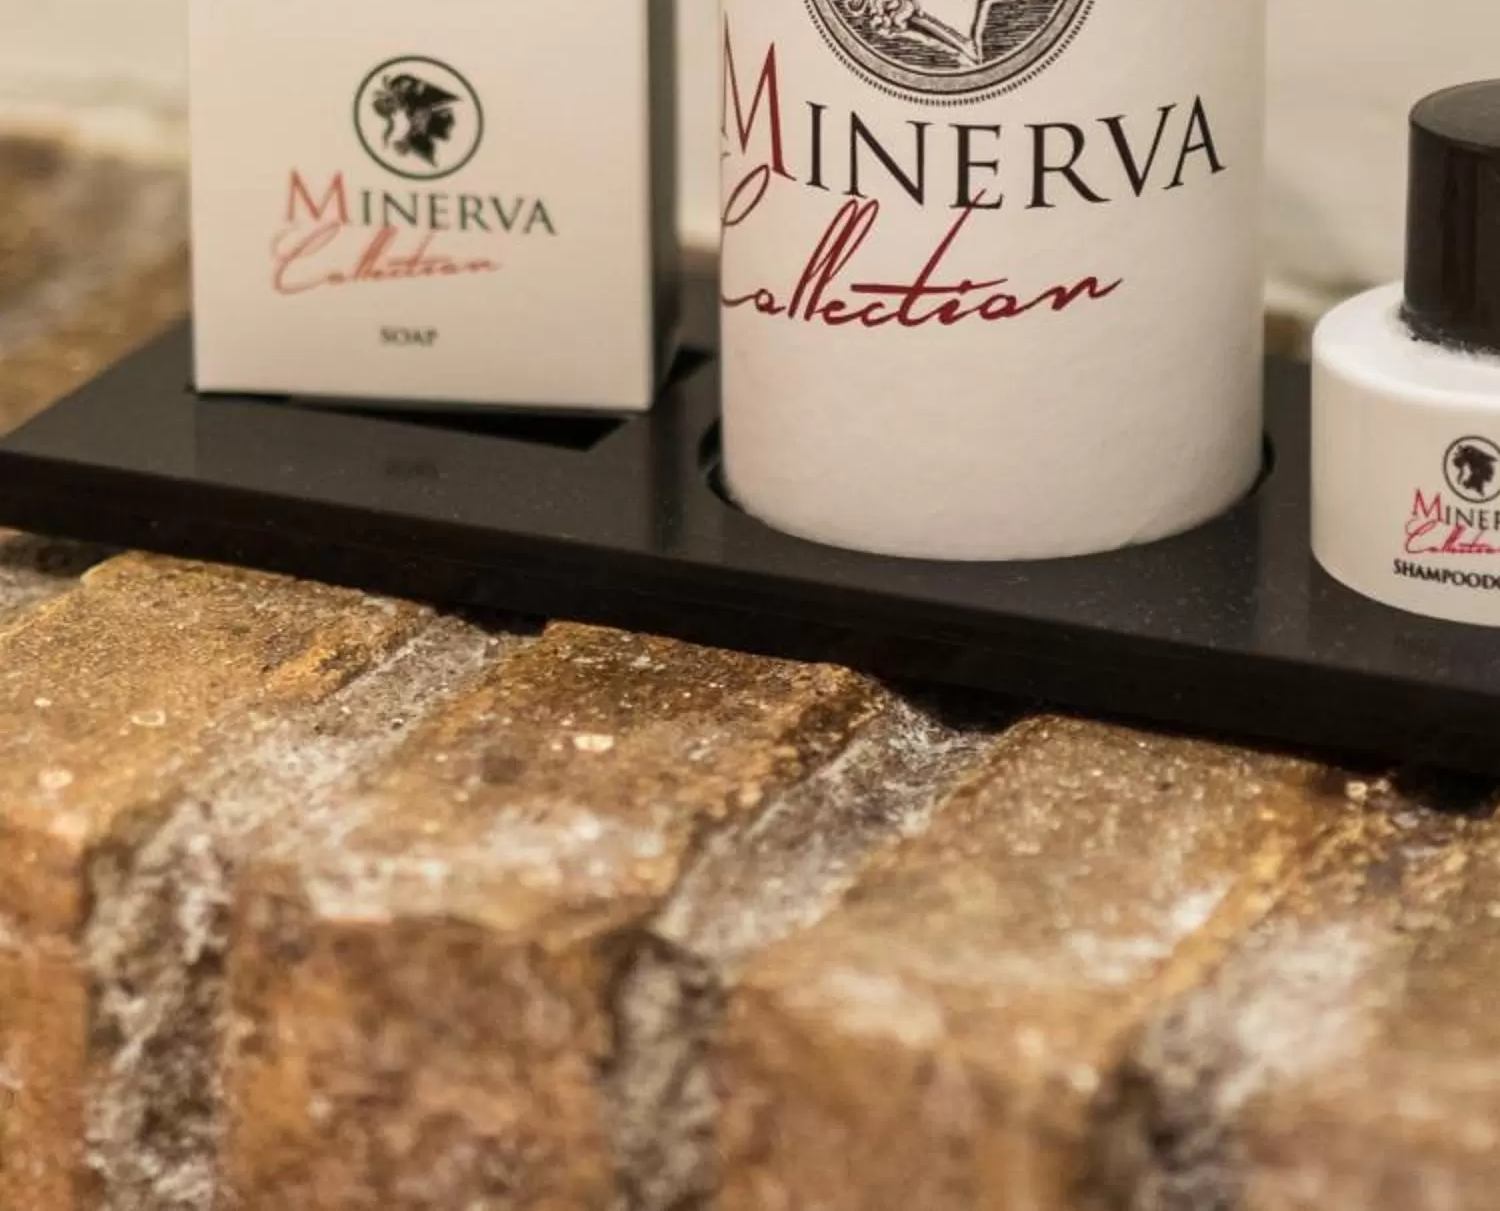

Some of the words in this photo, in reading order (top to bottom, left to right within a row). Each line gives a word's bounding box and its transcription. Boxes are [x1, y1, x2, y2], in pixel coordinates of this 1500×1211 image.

[721, 8, 1226, 210] MINERVA
[285, 165, 558, 236] MINERVA
[379, 325, 438, 347] SOAP
